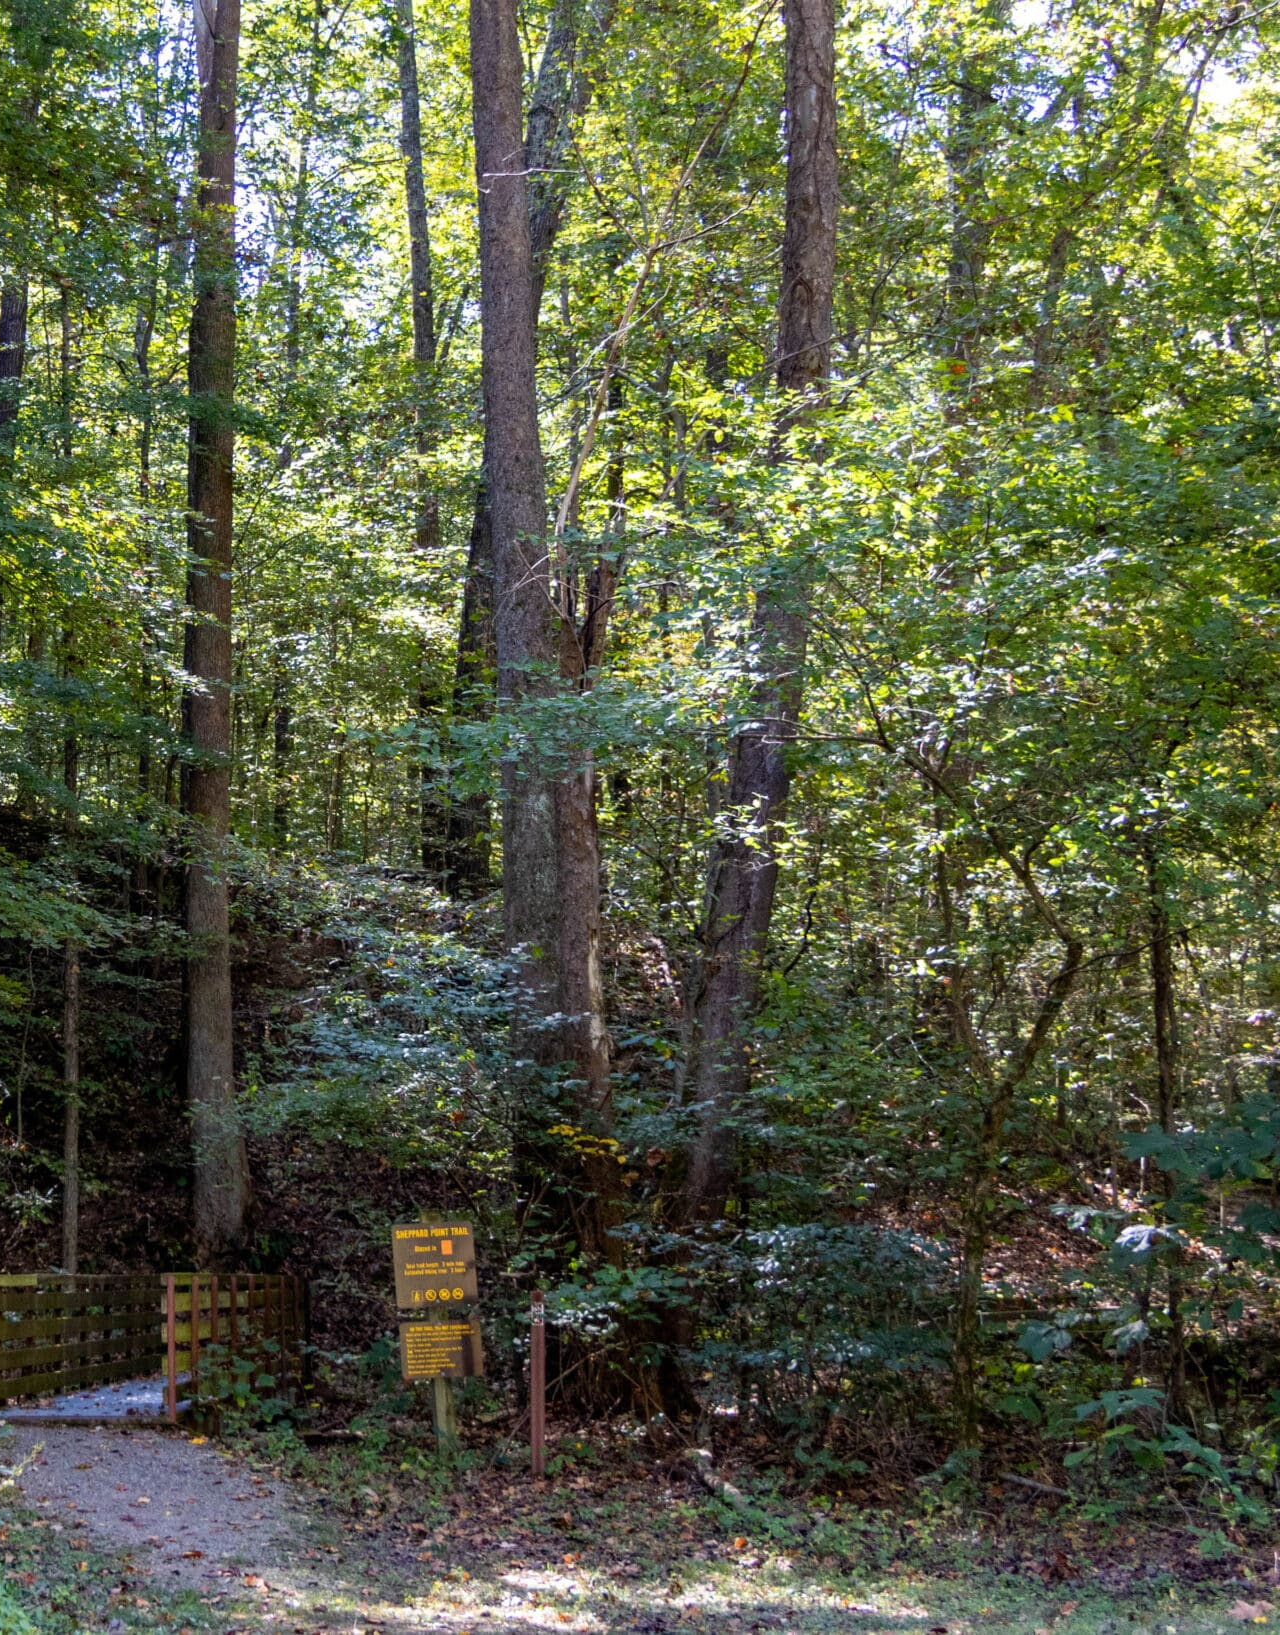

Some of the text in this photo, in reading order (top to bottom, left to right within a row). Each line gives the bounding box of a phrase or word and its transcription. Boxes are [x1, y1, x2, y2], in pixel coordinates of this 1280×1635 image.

[395, 1226, 469, 1239] SHEPPARD POINT TRAIL
